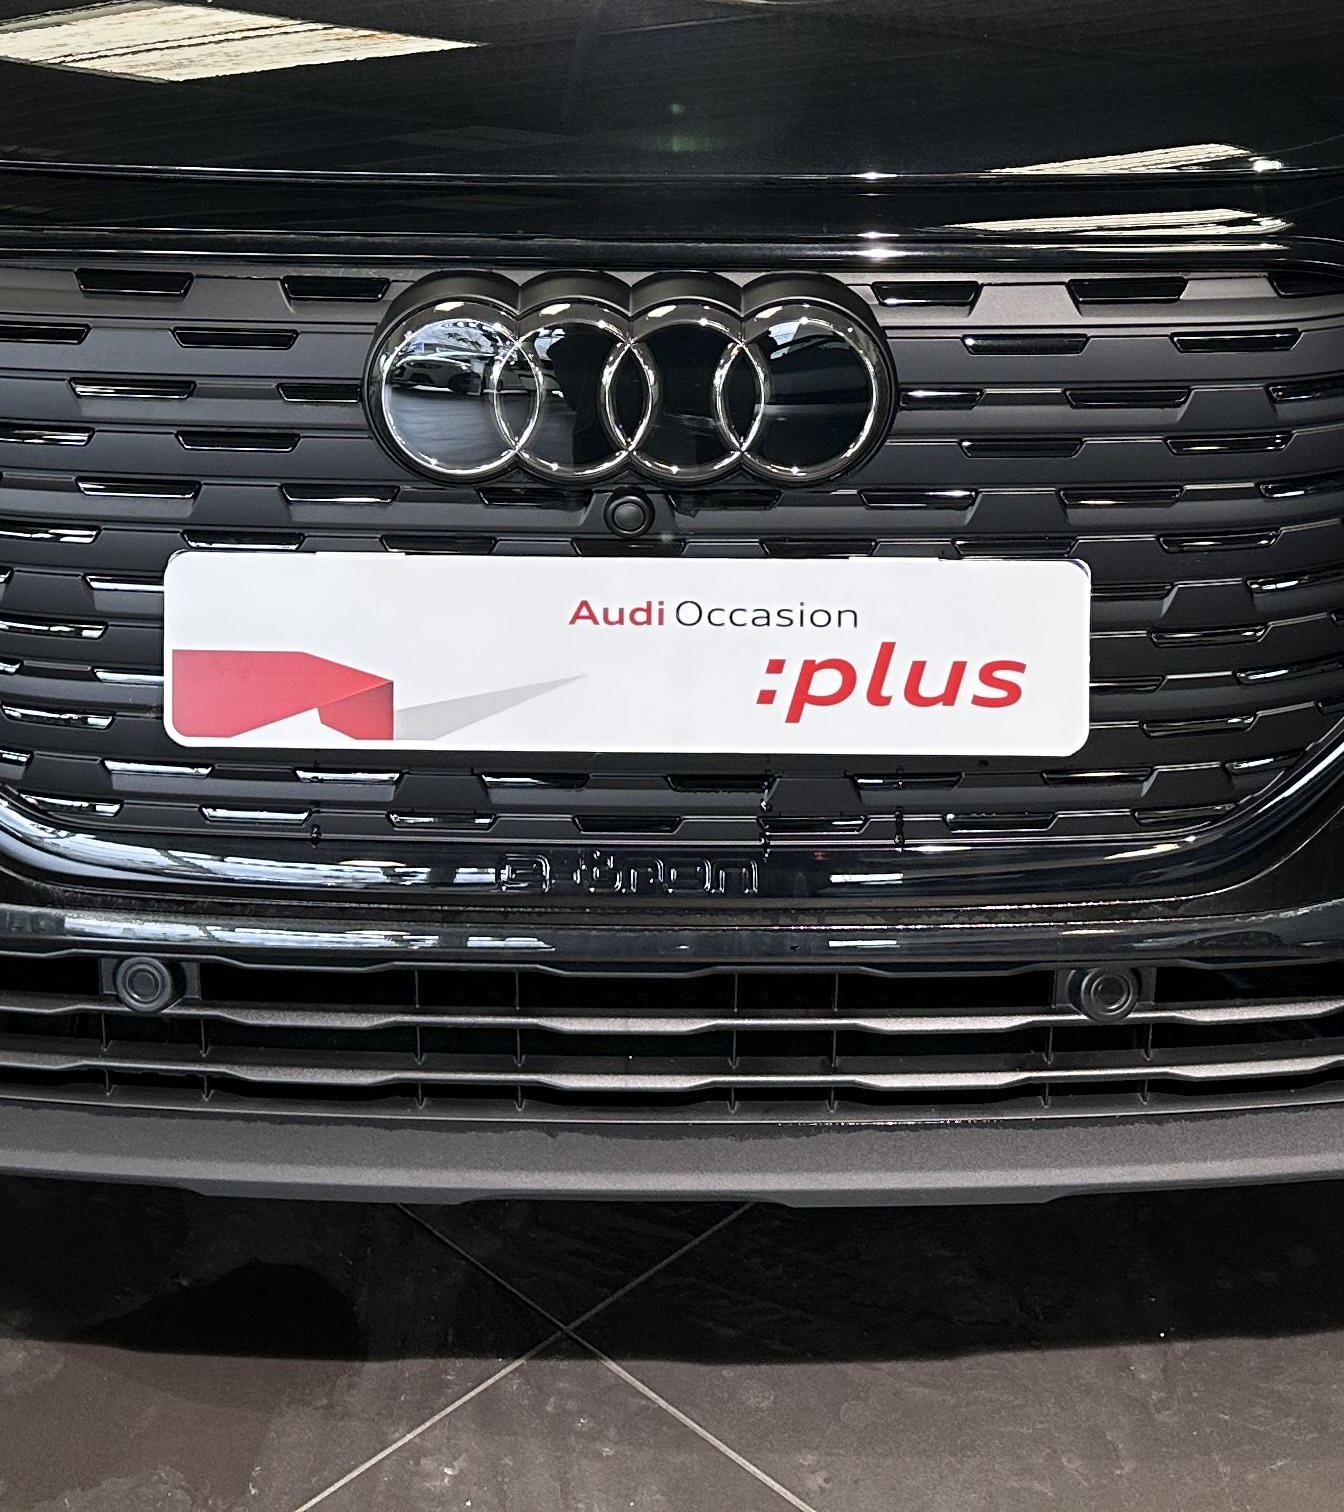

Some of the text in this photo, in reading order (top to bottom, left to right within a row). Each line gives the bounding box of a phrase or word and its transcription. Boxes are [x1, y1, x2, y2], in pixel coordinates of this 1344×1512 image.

[568, 599, 859, 629] Audi Occasion
[756, 641, 1027, 724] :plus
